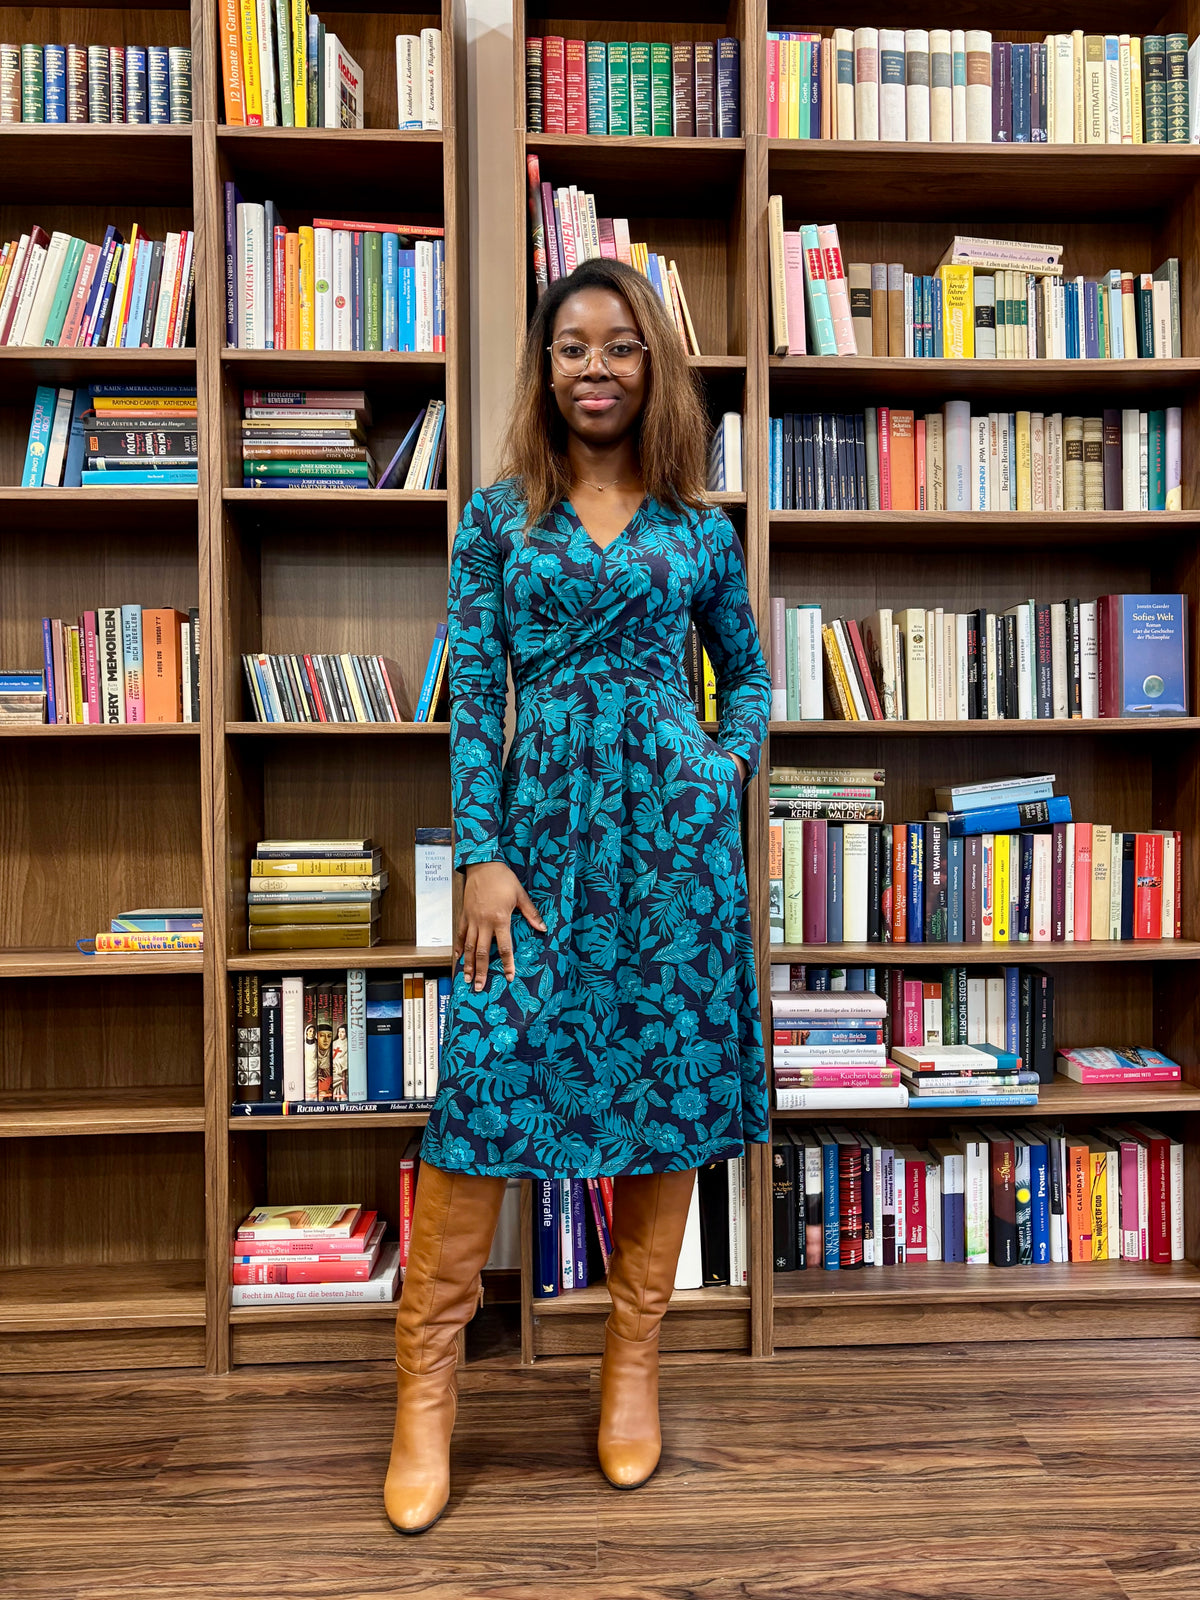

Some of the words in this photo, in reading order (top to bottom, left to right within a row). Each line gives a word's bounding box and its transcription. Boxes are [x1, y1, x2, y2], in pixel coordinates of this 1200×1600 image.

[244, 12, 252, 41] GARTEN
[279, 4, 287, 33] Zimmer
[228, 35, 237, 47] im
[229, 50, 239, 88] Monate
[281, 50, 290, 81] Pflanzen
[231, 92, 240, 102] 12
[1109, 65, 1119, 114] Strittmatter
[1092, 72, 1100, 137] STRITTMATTER
[549, 226, 559, 276] FRANKREICH
[562, 222, 576, 270] KOCHEN
[101, 260, 112, 287] KONSTANZ
[99, 298, 109, 318] Valencia
[32, 405, 43, 440] PICOULT
[42, 416, 50, 431] JODI
[126, 433, 135, 443] DU
[126, 444, 135, 454] DU
[1133, 613, 1155, 621] Sofies
[1157, 613, 1173, 621] Welt
[105, 611, 117, 681] MEMOIREN
[108, 693, 119, 723] DÉRY
[791, 810, 818, 818] KERLE
[828, 811, 865, 819] WALDEN
[350, 972, 363, 1029] ARTUS
[959, 1005, 967, 1036] HJORTH
[297, 1104, 324, 1113] RICHARD
[326, 1104, 338, 1112] VON
[340, 1103, 377, 1112] WEIZSÄCKER
